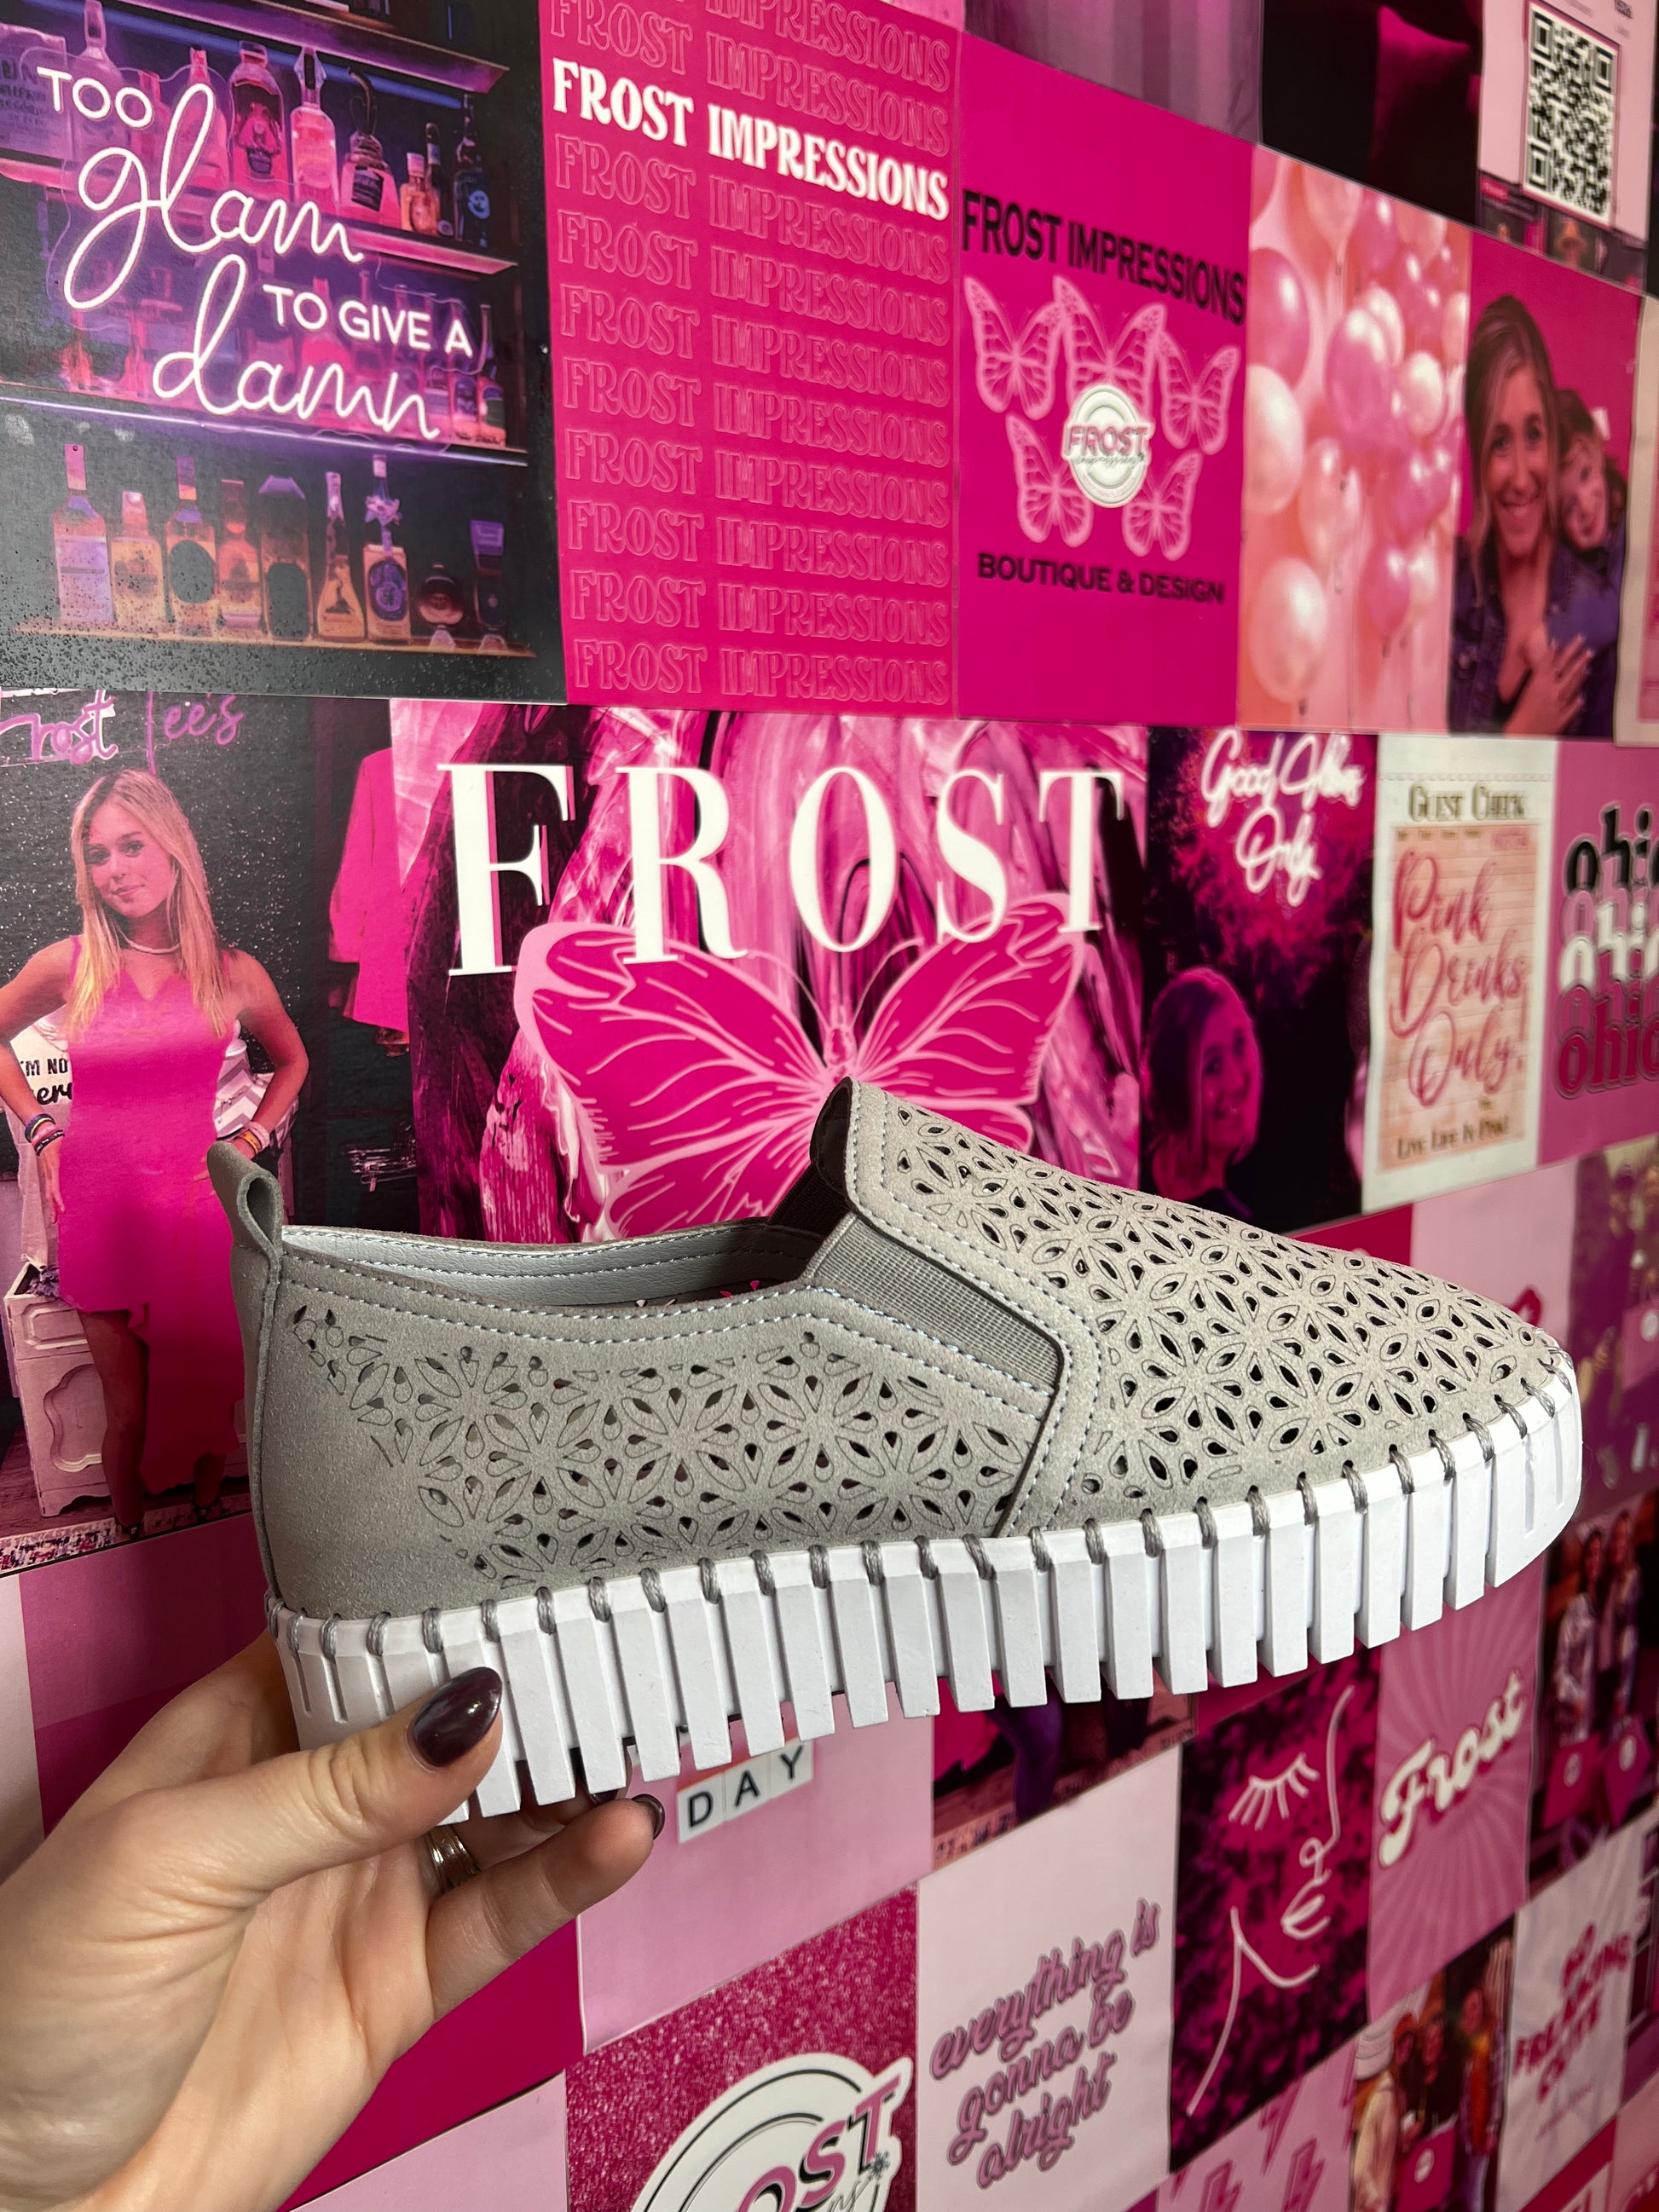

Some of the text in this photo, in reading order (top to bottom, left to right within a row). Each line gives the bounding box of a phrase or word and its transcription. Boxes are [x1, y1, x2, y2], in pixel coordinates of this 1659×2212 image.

[37, 66, 153, 127] TOO
[552, 57, 950, 221] FROST IMPRESSIONS
[706, 32, 951, 157] IMPRESSIONS
[64, 84, 364, 309] glam
[554, 134, 951, 285] FROST IMPRESSIONS
[558, 209, 951, 346] FROST IMPRESSIONS
[962, 190, 1246, 326] FROST IMPRESSIONS
[153, 254, 441, 439] damn
[263, 285, 473, 357] TO GIVE A
[560, 283, 951, 407] FROST IMPRESSIONS
[563, 356, 951, 467] FROST IMPRESSIONS
[1066, 425, 1148, 456] FROST
[564, 428, 951, 528] FROST IMPRESSIONS
[567, 500, 951, 587] FROST IMPRESSIONS
[978, 553, 1226, 605] BOUTIQUE & DESIGN
[569, 569, 951, 647] FROST IMPRESSIONS
[573, 638, 951, 705] FROST IMPRESSIONS
[437, 764, 1126, 977] FROST
[1393, 852, 1497, 953] Pink
[1567, 806, 1659, 893] ohi
[1390, 929, 1527, 1039] Drinks
[687, 1744, 806, 1828] DAY
[1379, 1667, 1528, 1870] Frost
[928, 1896, 1162, 2081] everything is
[946, 1982, 1137, 2166] gonna be
[976, 2051, 1119, 2190] alright
